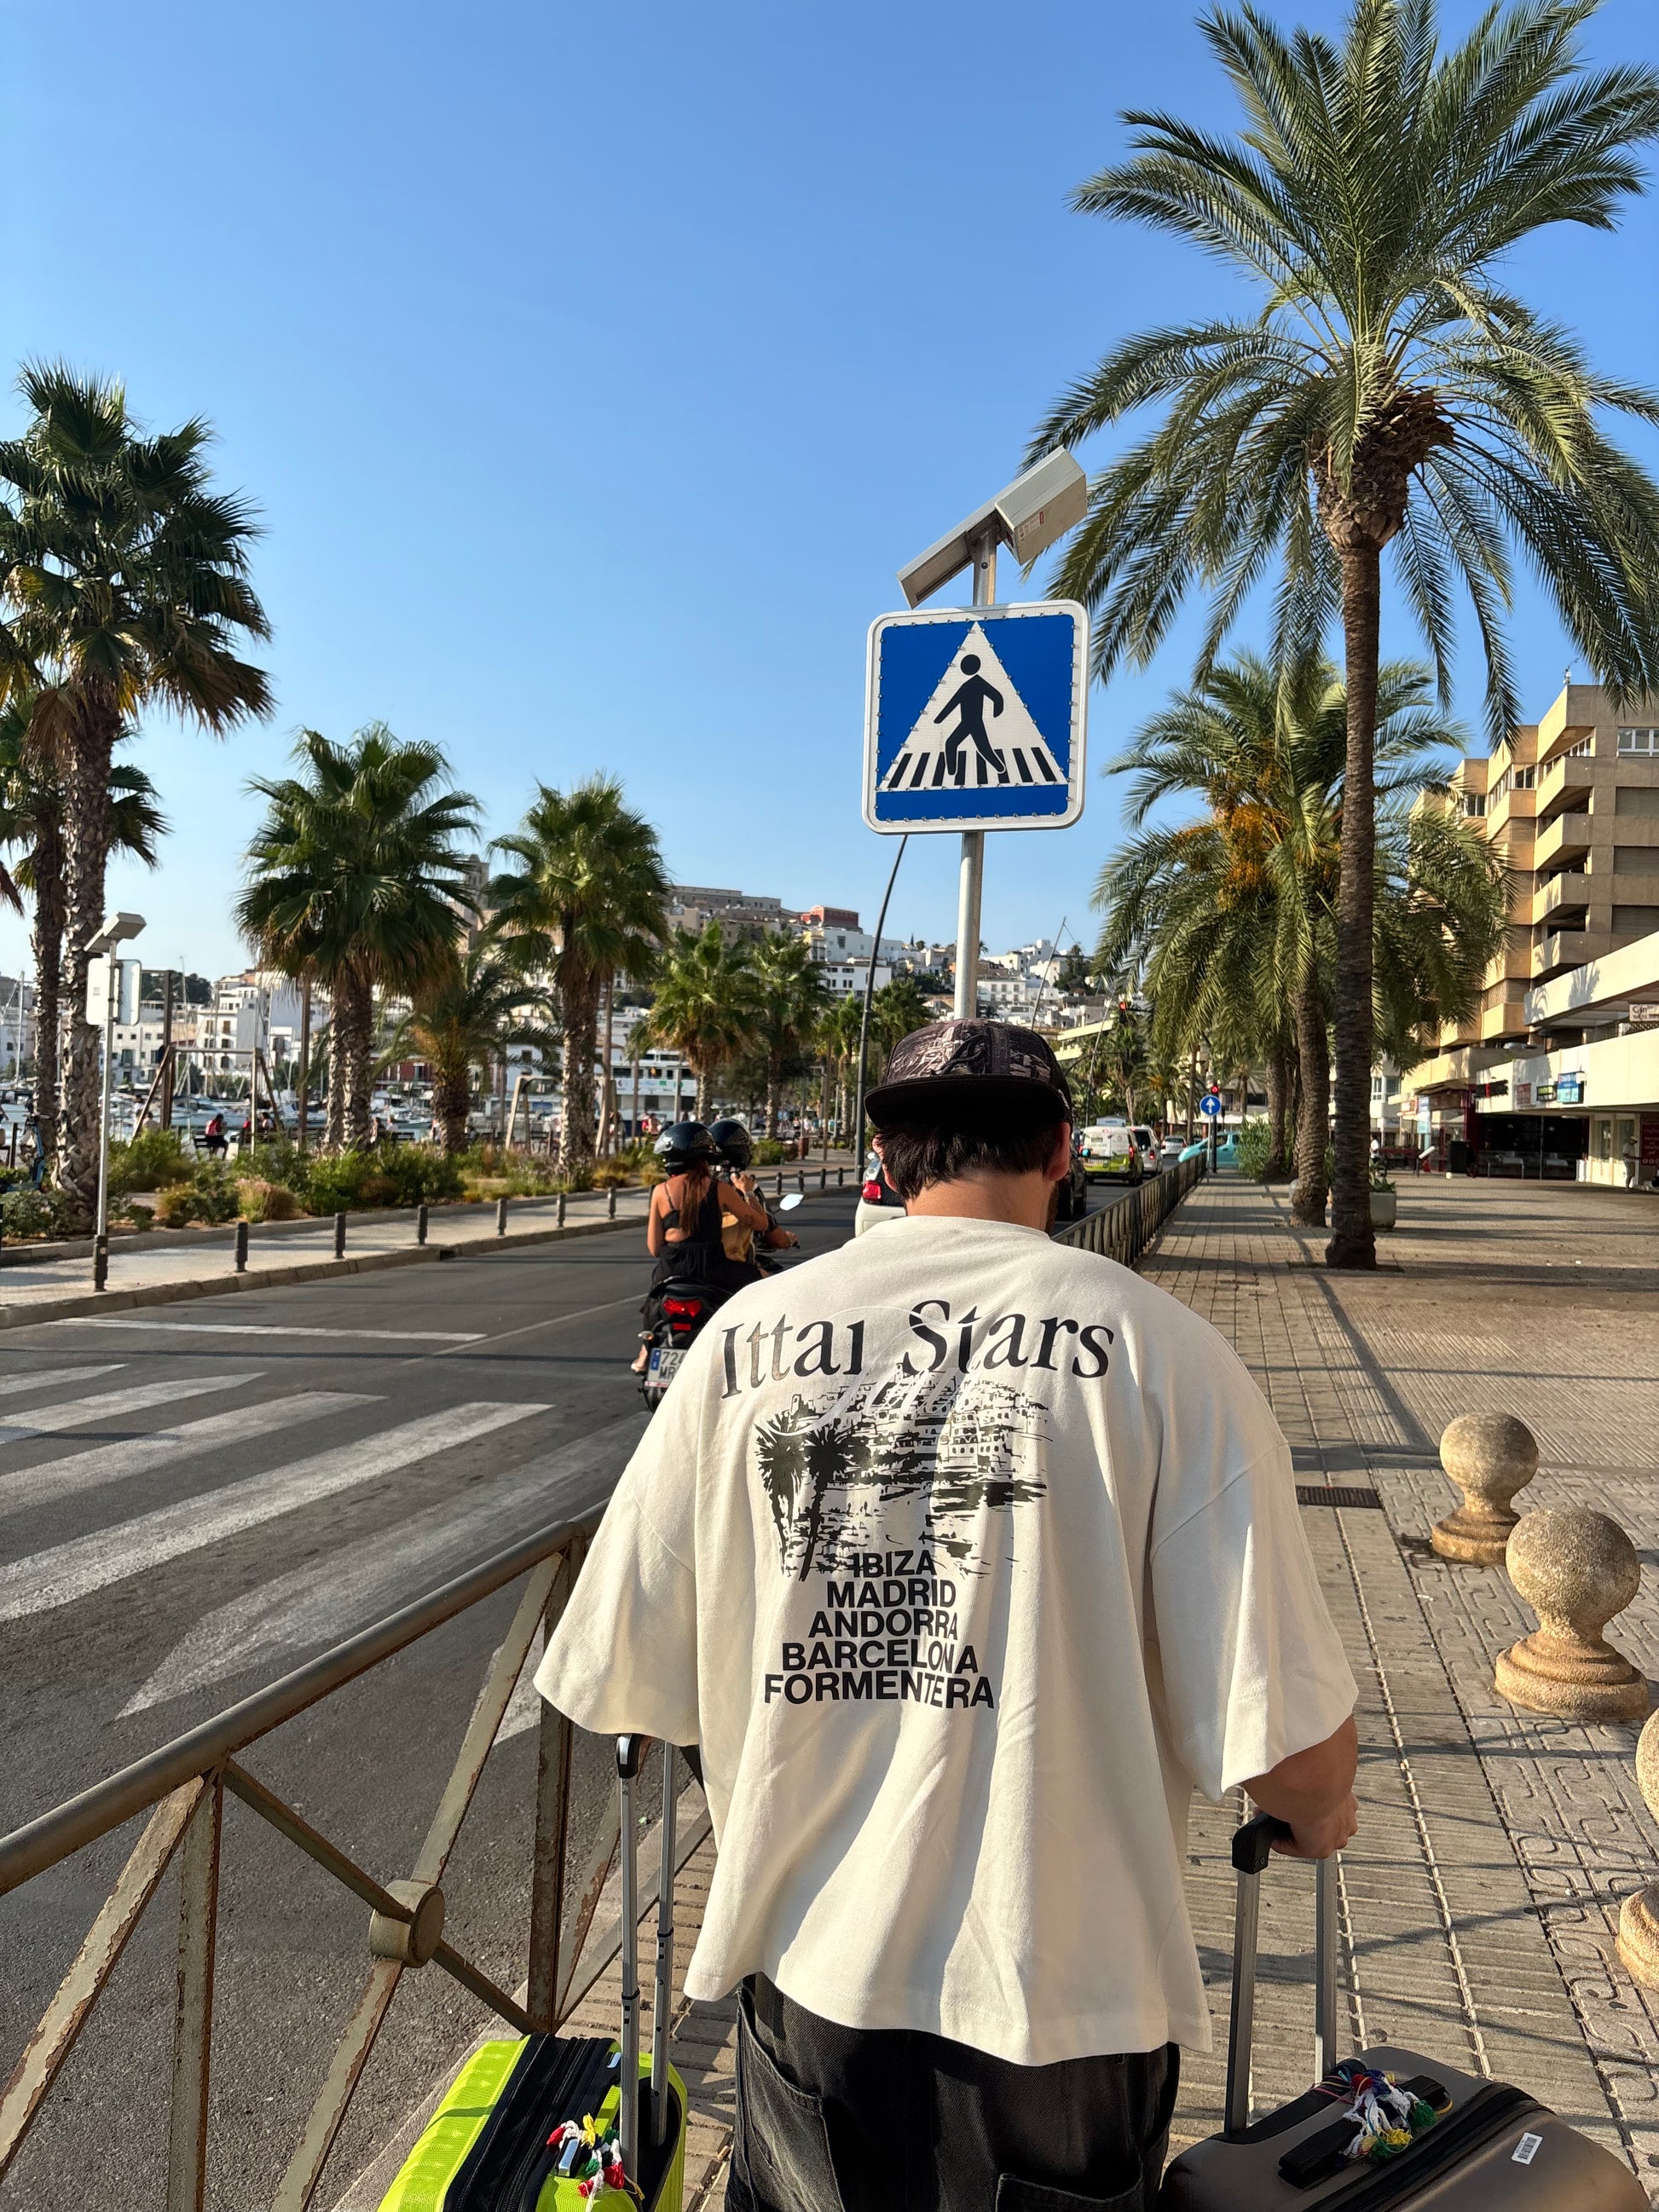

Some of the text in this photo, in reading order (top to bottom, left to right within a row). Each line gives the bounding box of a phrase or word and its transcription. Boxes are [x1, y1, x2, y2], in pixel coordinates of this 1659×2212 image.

[901, 1299, 1114, 1378] Stars
[659, 1366, 680, 1379] MR
[662, 1351, 686, 1366] 72
[853, 1550, 937, 1578] IBIZA
[827, 1579, 957, 1608] MADRID
[808, 1608, 957, 1640] ANDORRA
[782, 1639, 979, 1674] BARCELONA
[764, 1670, 994, 1708] FORMENTERA
